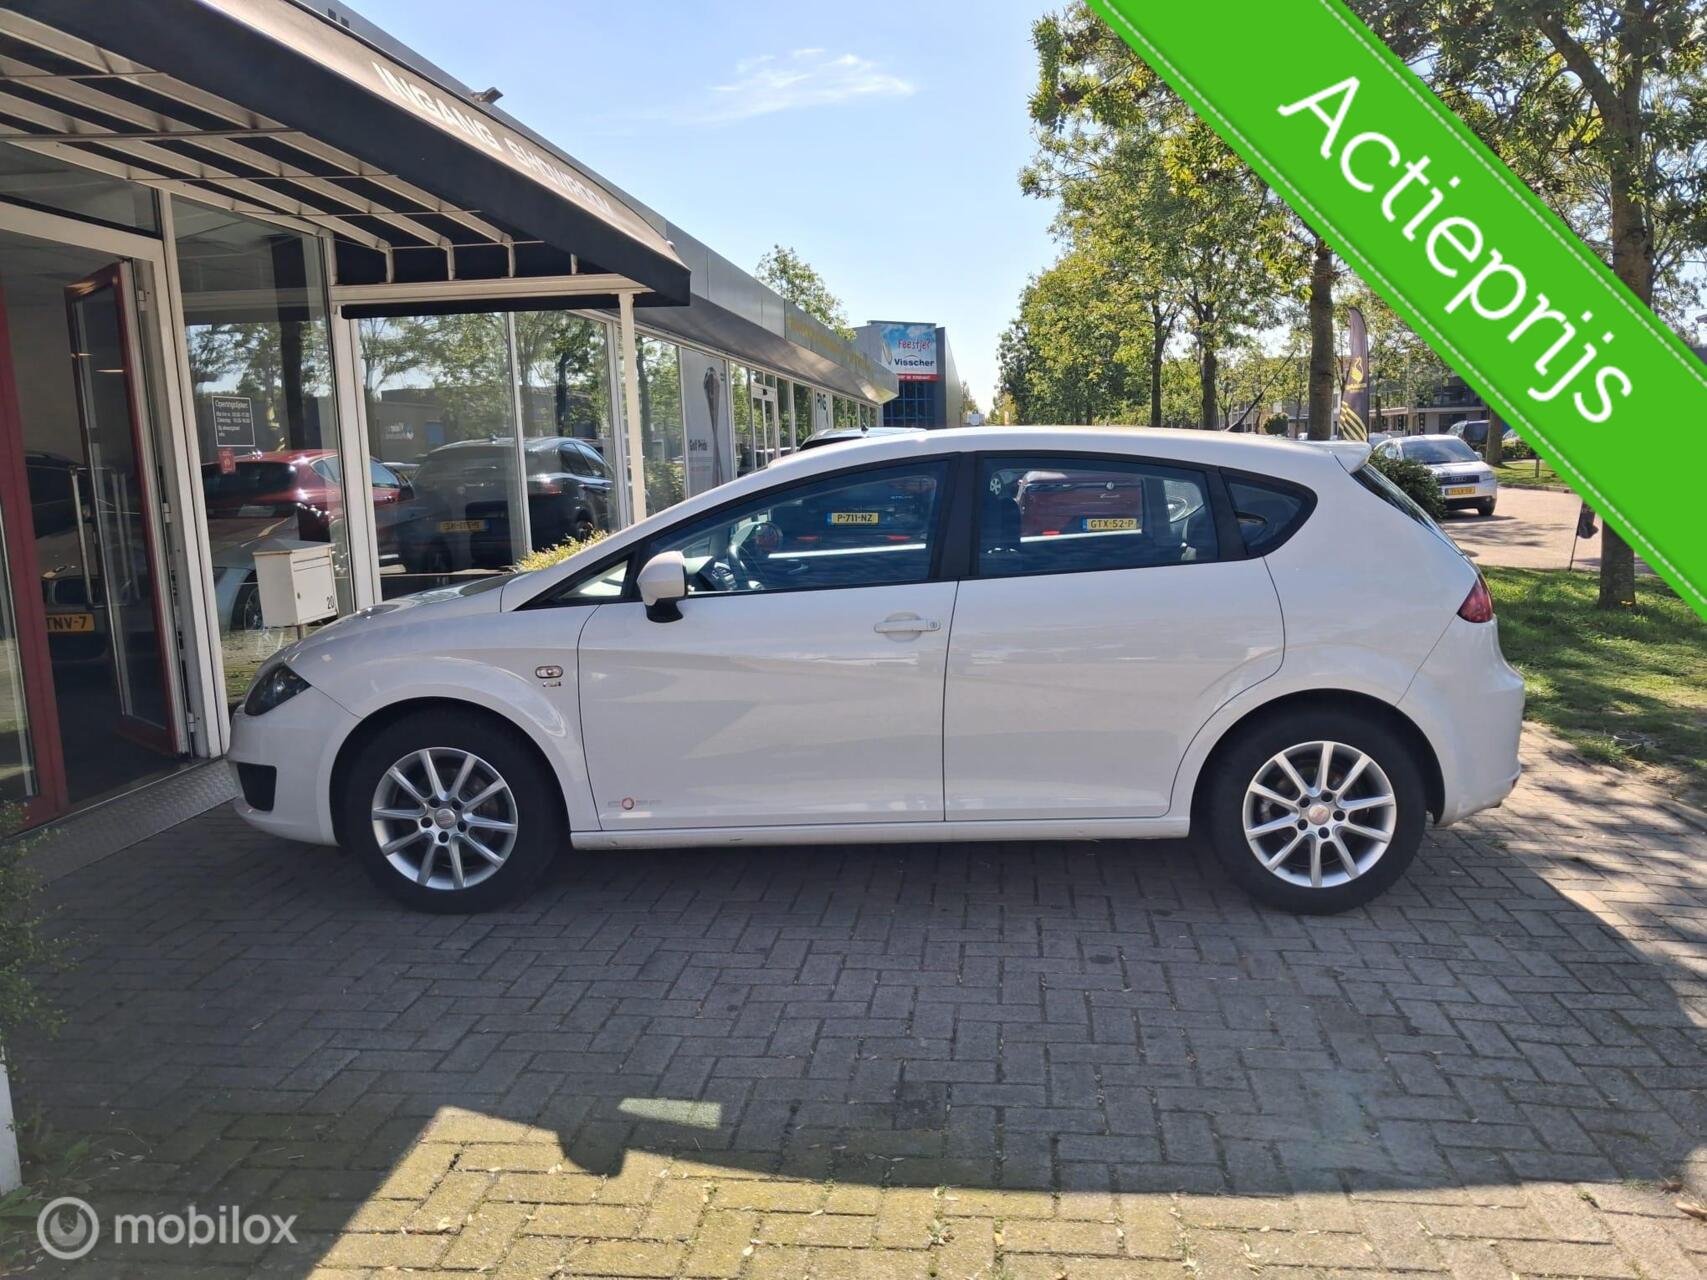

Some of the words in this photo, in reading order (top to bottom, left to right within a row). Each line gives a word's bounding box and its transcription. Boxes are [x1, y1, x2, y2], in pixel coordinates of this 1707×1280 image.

[373, 62, 502, 151] INGANG
[895, 358, 935, 366] Visscher
[836, 513, 873, 522] P-711-NZ
[1090, 519, 1134, 528] GTX-52-P
[326, 595, 335, 609] 20
